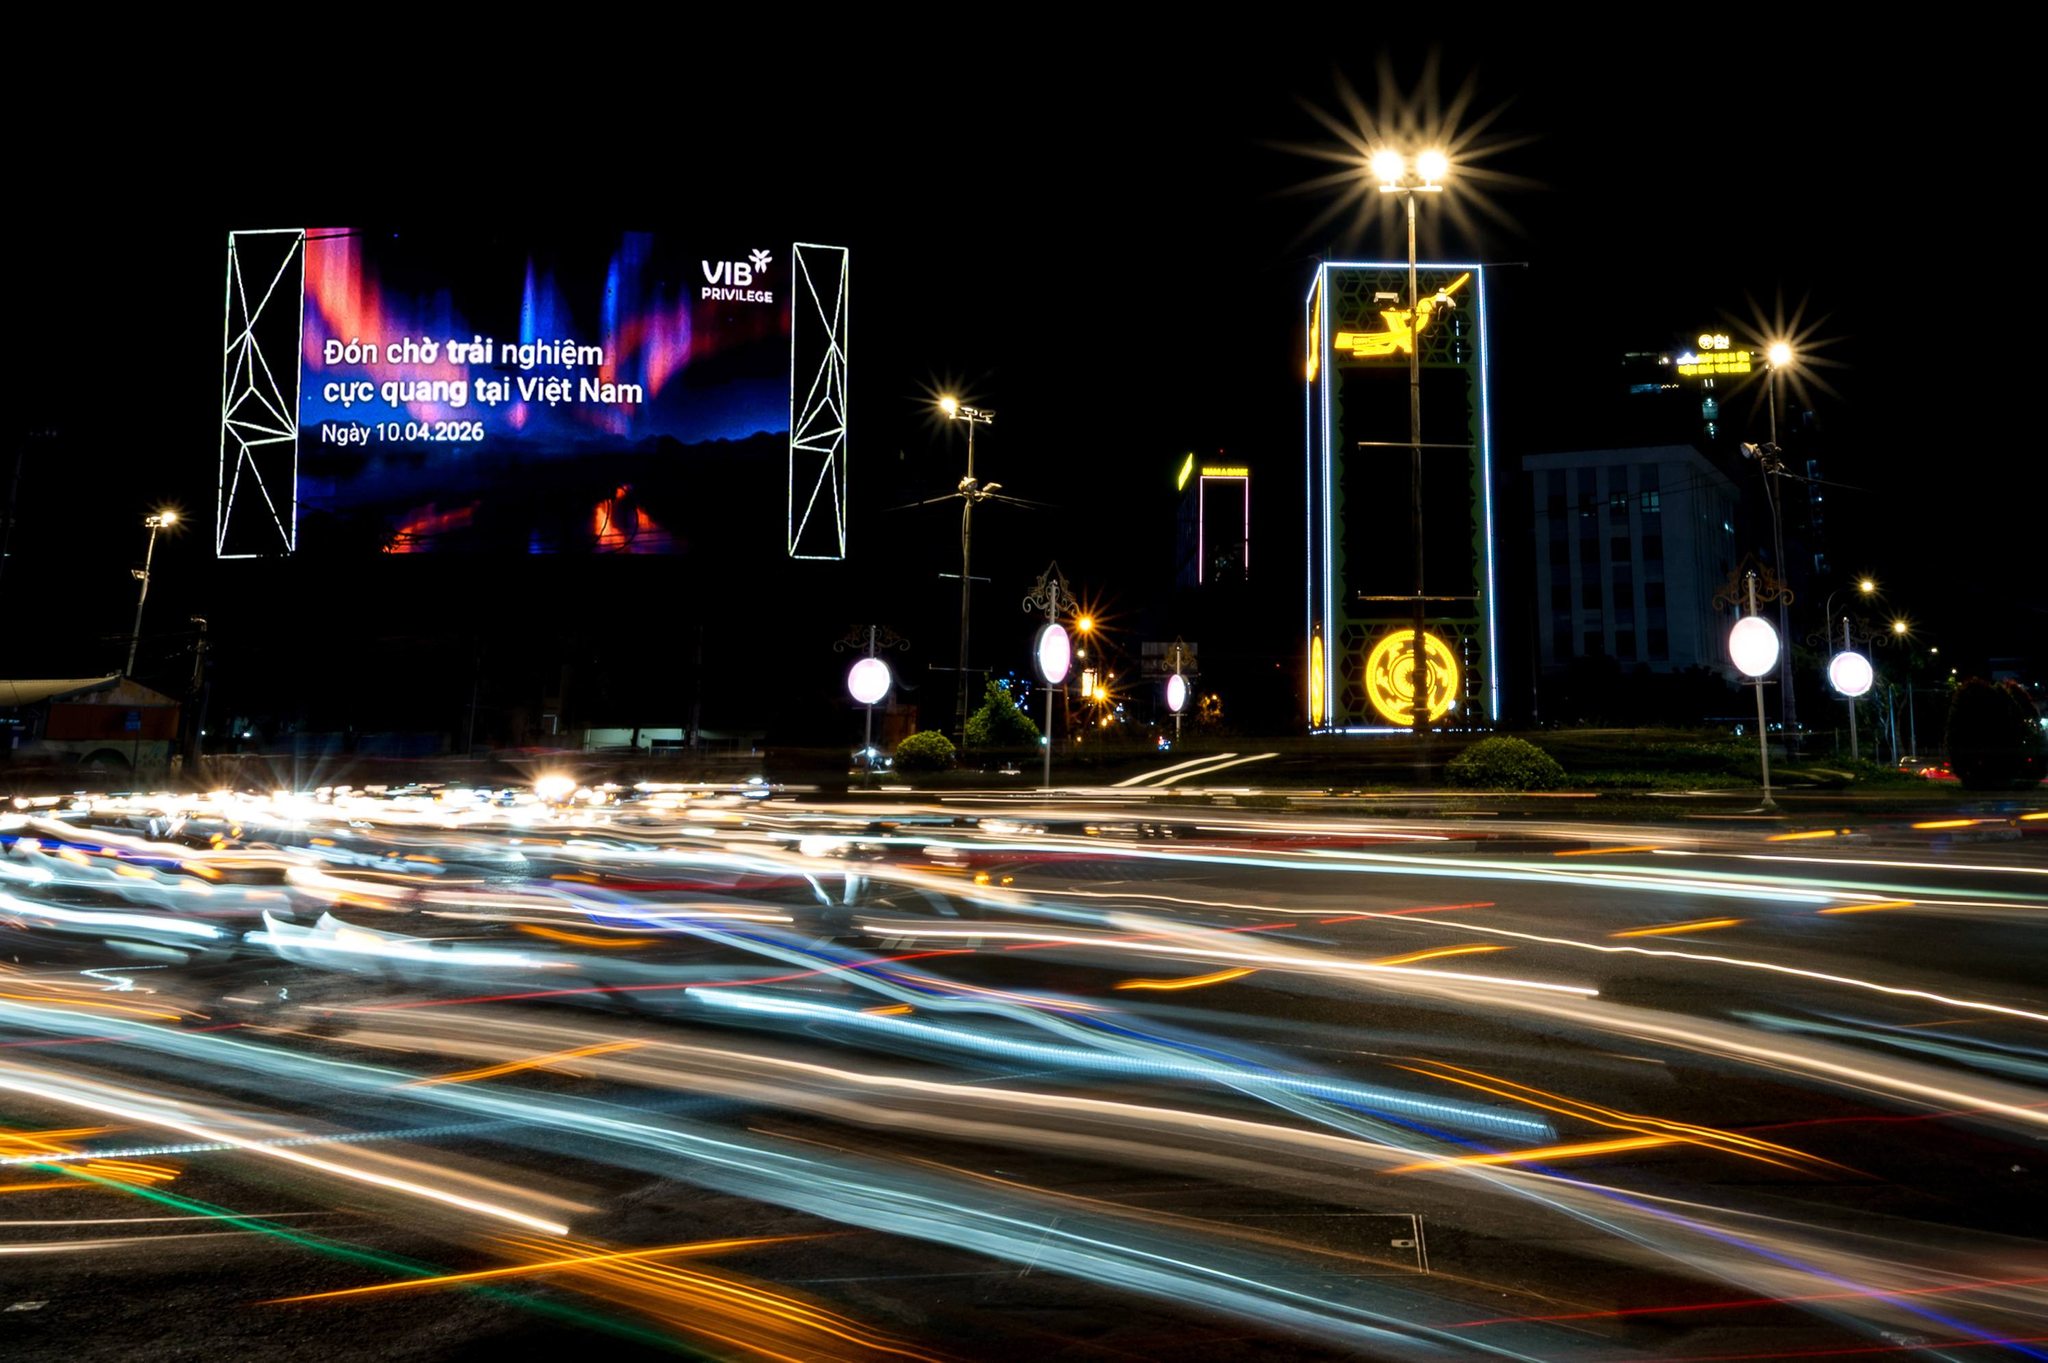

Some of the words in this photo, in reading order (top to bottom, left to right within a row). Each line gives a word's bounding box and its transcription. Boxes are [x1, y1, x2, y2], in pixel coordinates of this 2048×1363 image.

[701, 259, 753, 286] VIB
[701, 287, 773, 303] PRIVILEGE
[323, 336, 378, 365] Đón
[386, 335, 439, 364] chờ
[446, 335, 493, 364] trải
[502, 338, 604, 370] nghiệm
[323, 381, 375, 408] cực
[381, 380, 467, 408] quang
[474, 376, 510, 406] tại
[516, 376, 572, 407] Việt
[579, 377, 643, 403] Nam
[322, 422, 371, 446] Ngày
[376, 421, 484, 442] 10.04.2026
